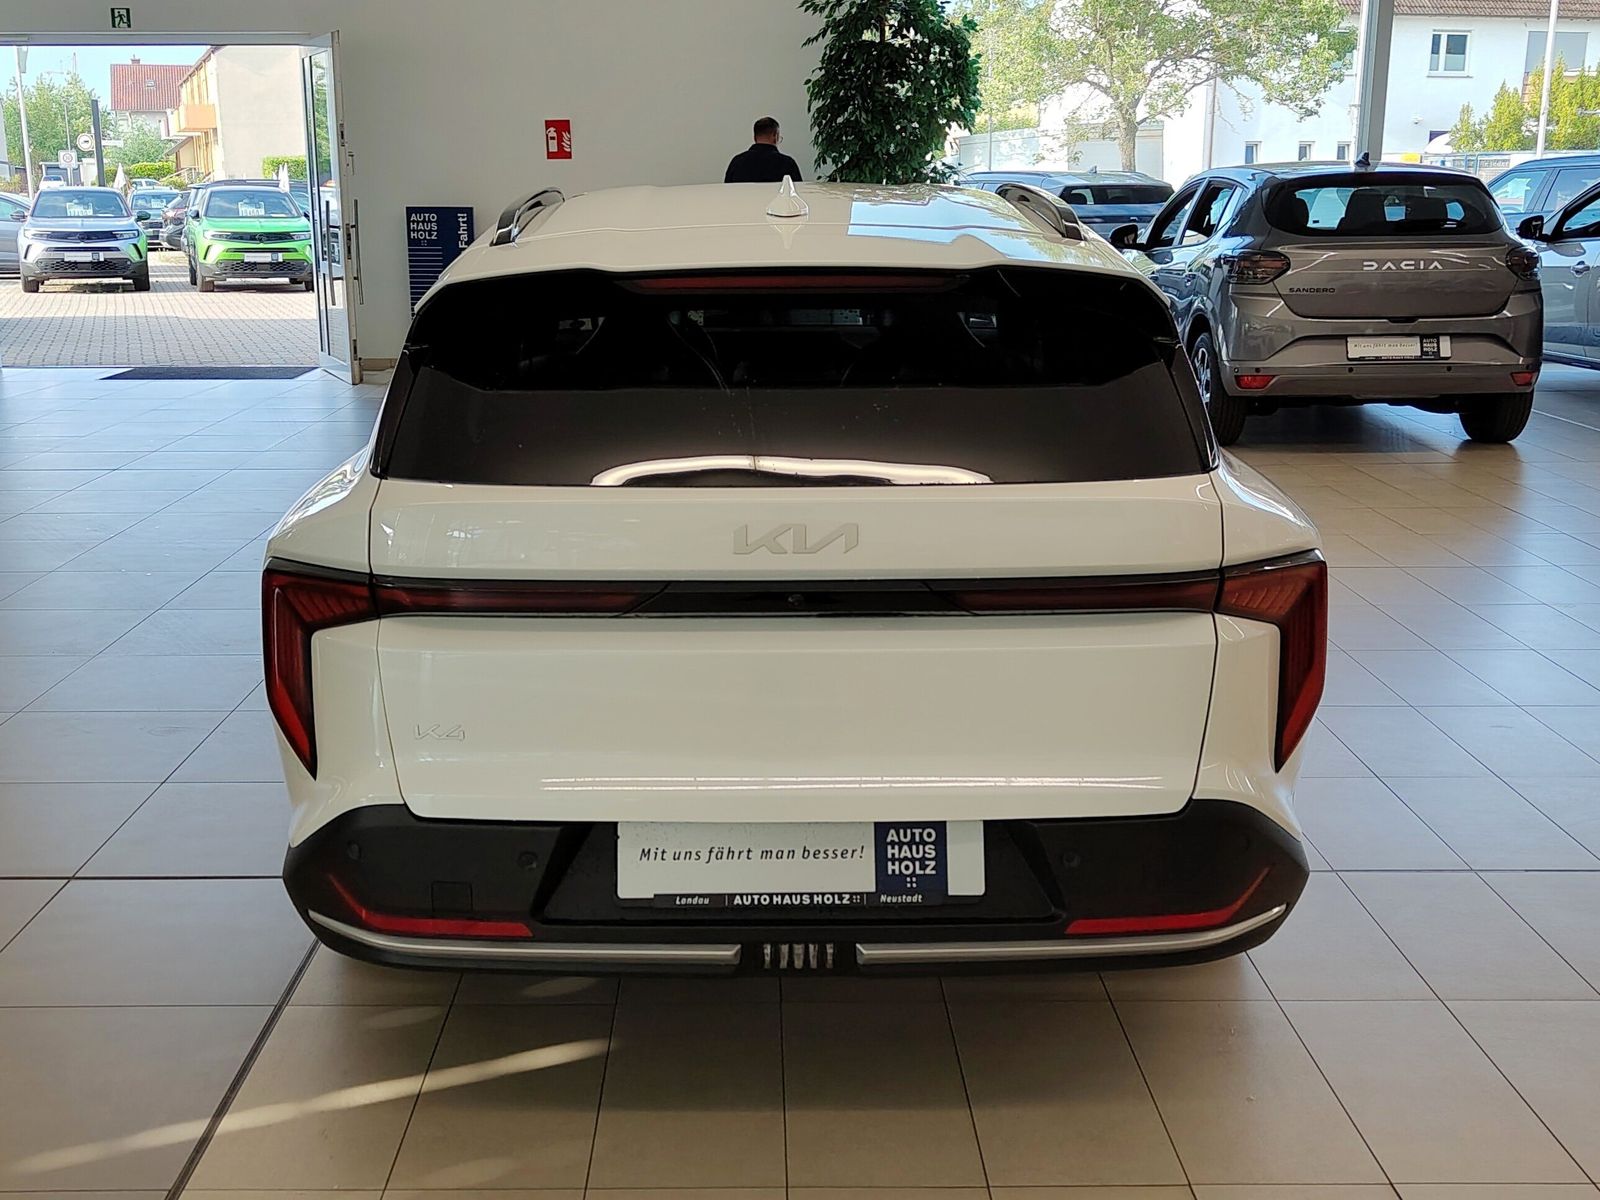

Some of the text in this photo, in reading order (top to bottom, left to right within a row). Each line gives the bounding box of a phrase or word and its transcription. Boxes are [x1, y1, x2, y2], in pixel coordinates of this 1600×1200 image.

[410, 213, 437, 221] AUTO
[410, 222, 437, 230] HAUS
[410, 231, 437, 239] HOLZ
[1363, 261, 1443, 270] DACIA
[733, 523, 859, 555] KIA
[414, 723, 466, 742] K4
[886, 828, 936, 842] AUTO
[639, 845, 865, 864] Mit uns fährt man besser!
[887, 844, 936, 858] HAUS
[887, 860, 936, 875] HOLZ
[675, 894, 923, 905] Landau AUTO HAUS HOLZ Neustadt
